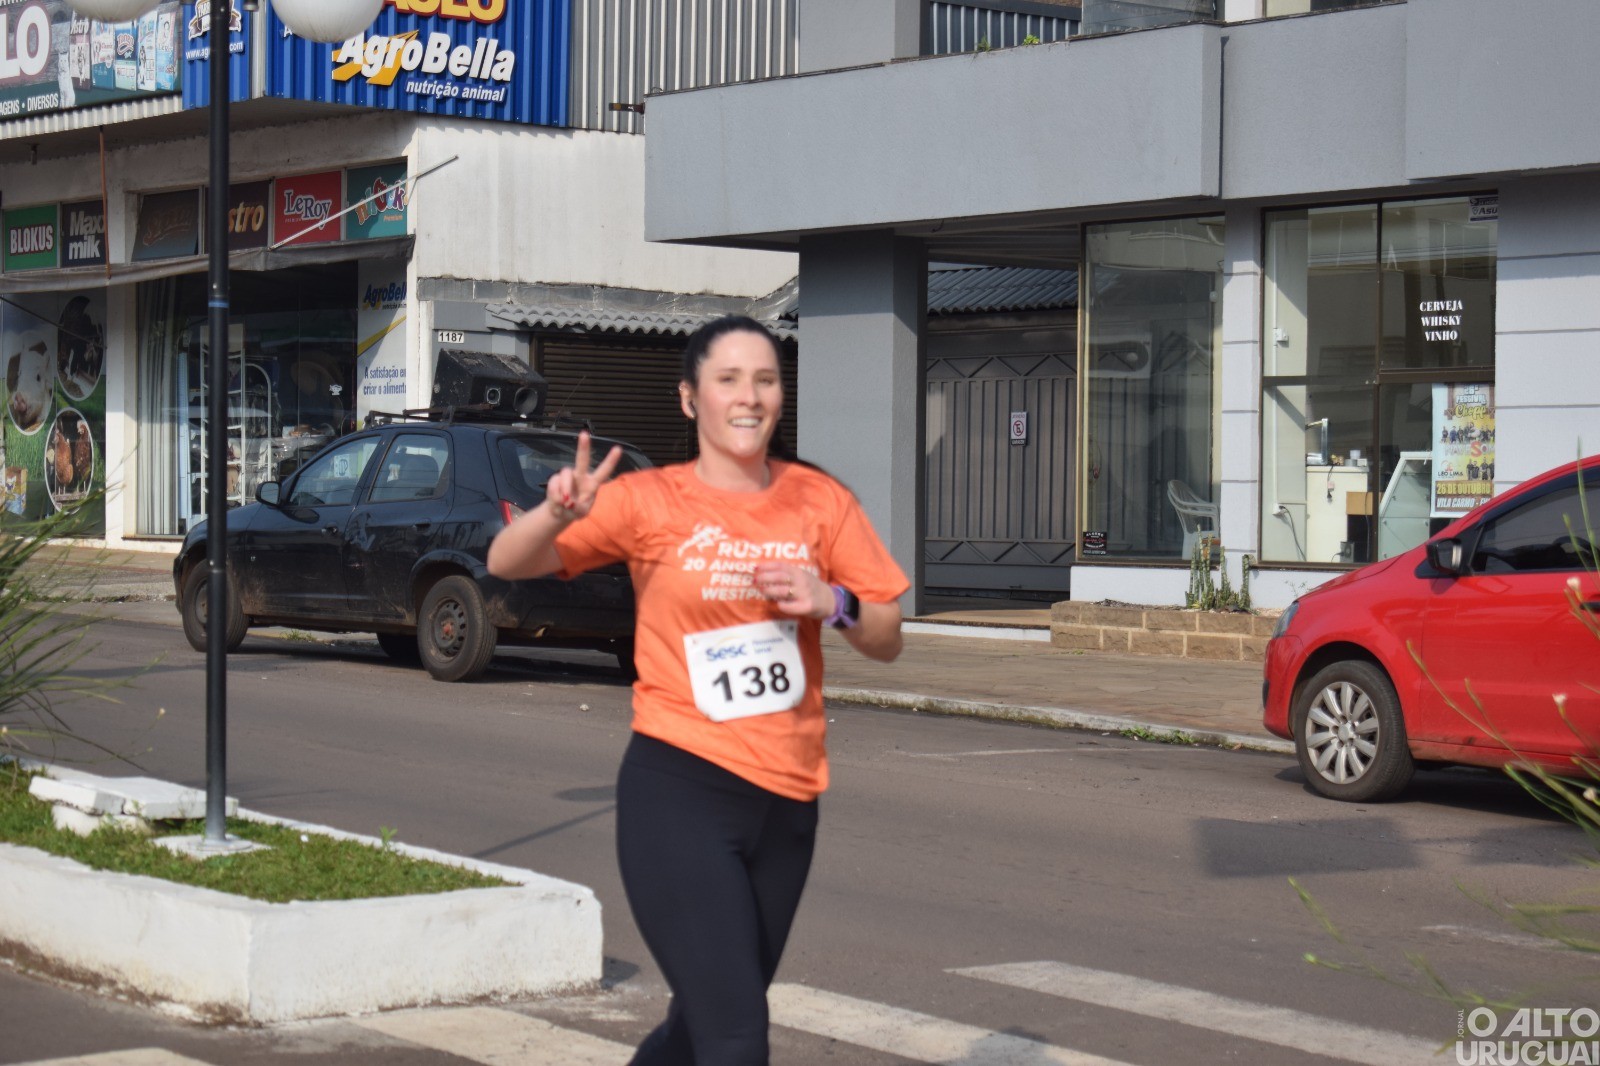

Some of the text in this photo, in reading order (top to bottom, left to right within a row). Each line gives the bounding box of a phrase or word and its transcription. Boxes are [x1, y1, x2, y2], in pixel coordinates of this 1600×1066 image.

[336, 30, 515, 82] AgroBella
[406, 79, 506, 102] nutrição animal
[27, 93, 59, 112] DIVERSOS
[227, 201, 265, 234] stro
[10, 225, 54, 254] BLOKUS
[68, 234, 101, 260] milk
[1419, 300, 1463, 312] CERVEJA
[1421, 315, 1462, 327] WHISKY
[439, 332, 464, 343] 1187
[1425, 331, 1458, 342] VINHO
[364, 366, 369, 379] A
[369, 365, 399, 382] satisfação
[363, 382, 378, 396] criar
[683, 558, 706, 571] 20
[712, 662, 790, 702] 138
